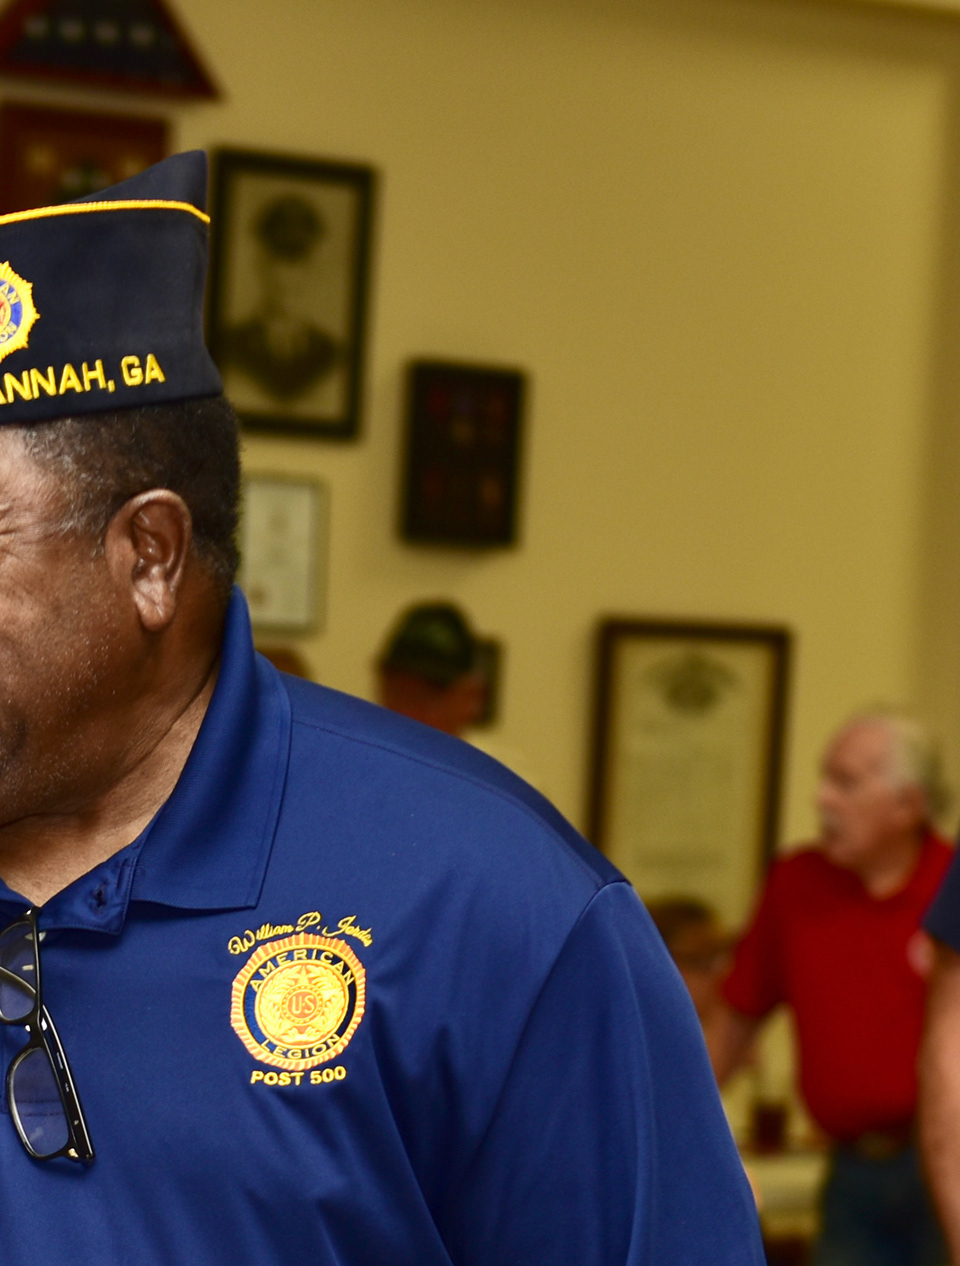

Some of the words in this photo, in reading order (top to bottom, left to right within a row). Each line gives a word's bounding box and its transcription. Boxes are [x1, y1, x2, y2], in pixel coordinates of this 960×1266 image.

[121, 353, 166, 387] GA
[228, 923, 294, 955] William
[295, 911, 322, 932] P.
[250, 949, 355, 992] AMERICAN
[291, 995, 315, 1014] US
[261, 1033, 341, 1059] LEGION
[250, 1070, 305, 1086] POST
[310, 1066, 347, 1084] 500
